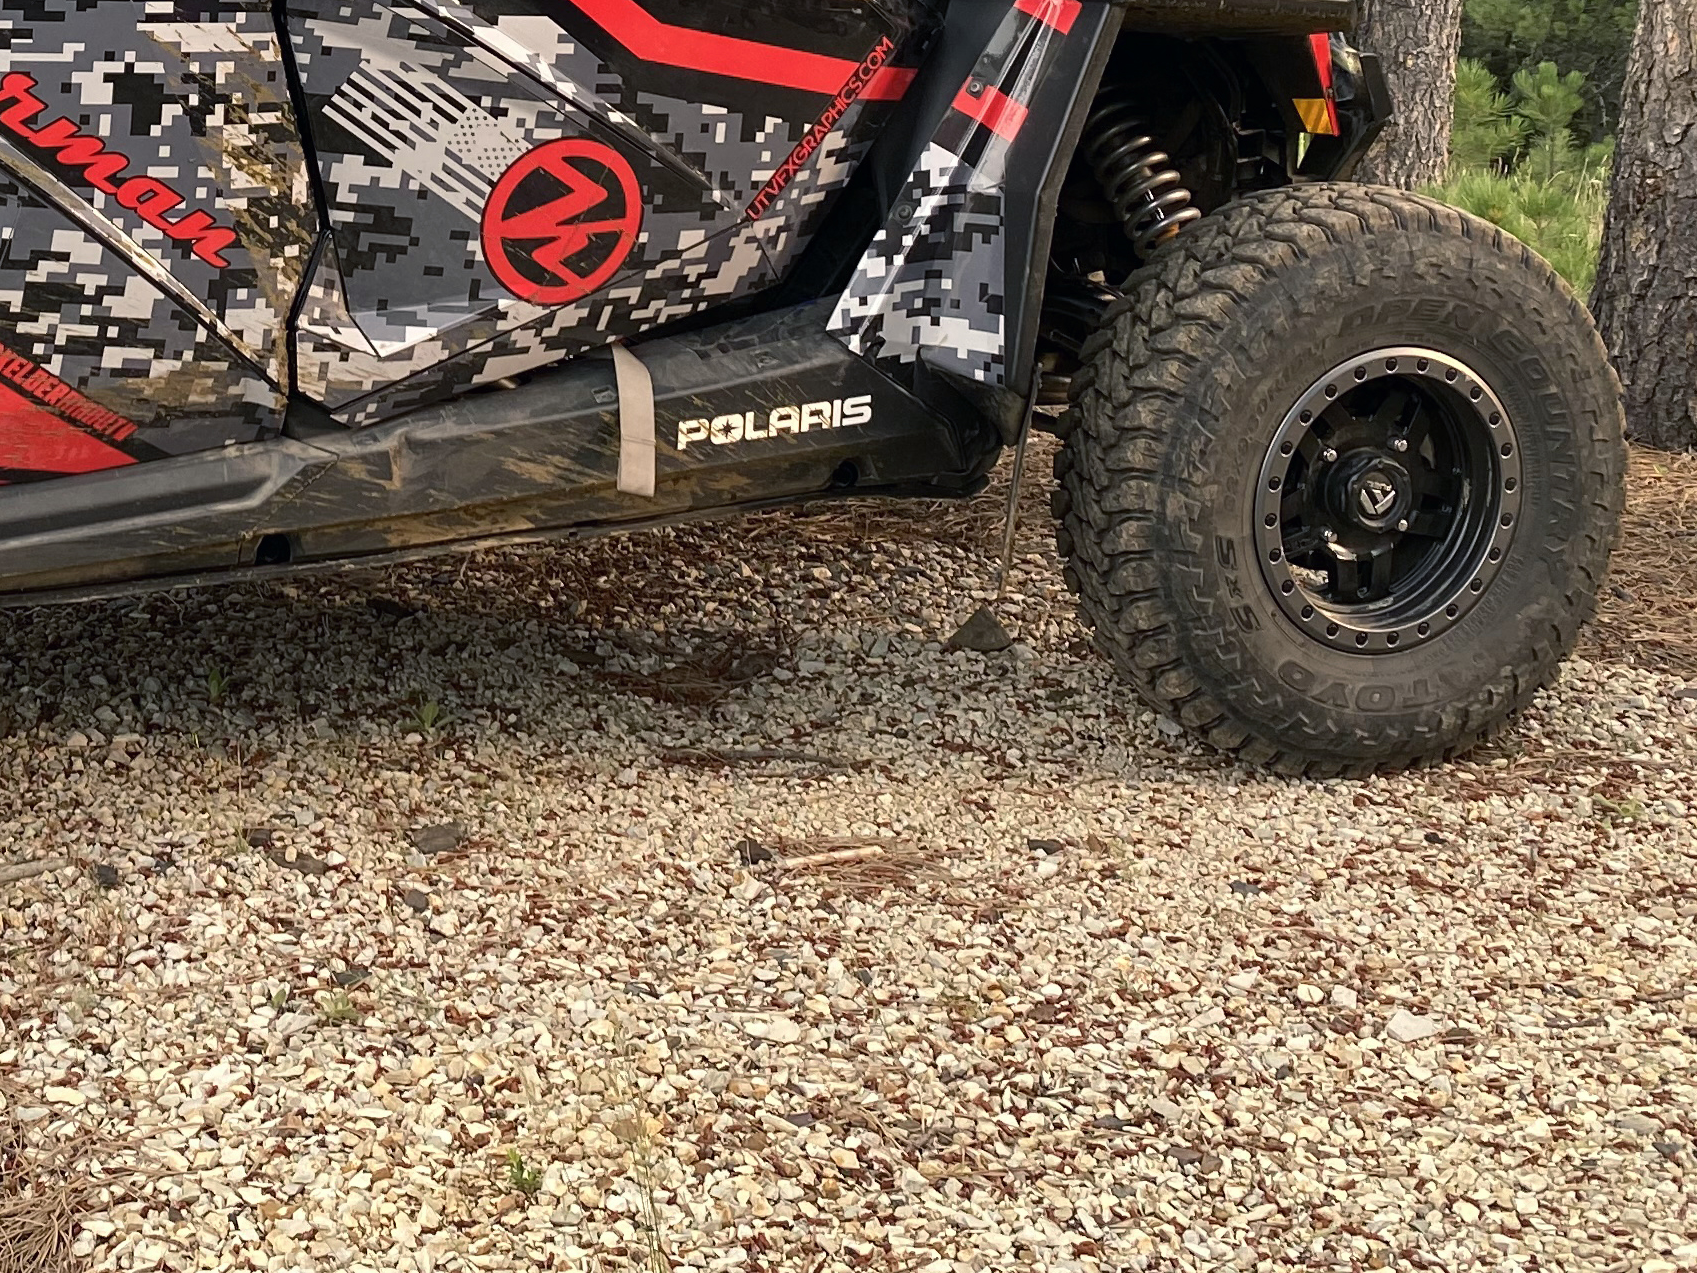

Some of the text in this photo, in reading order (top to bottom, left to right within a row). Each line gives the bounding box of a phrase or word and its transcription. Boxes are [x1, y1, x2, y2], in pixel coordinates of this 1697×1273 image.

[747, 35, 895, 220] UTVFXGRAPHICS.COM
[676, 394, 872, 451] POLARIS
[1278, 659, 1439, 712] TOYO
